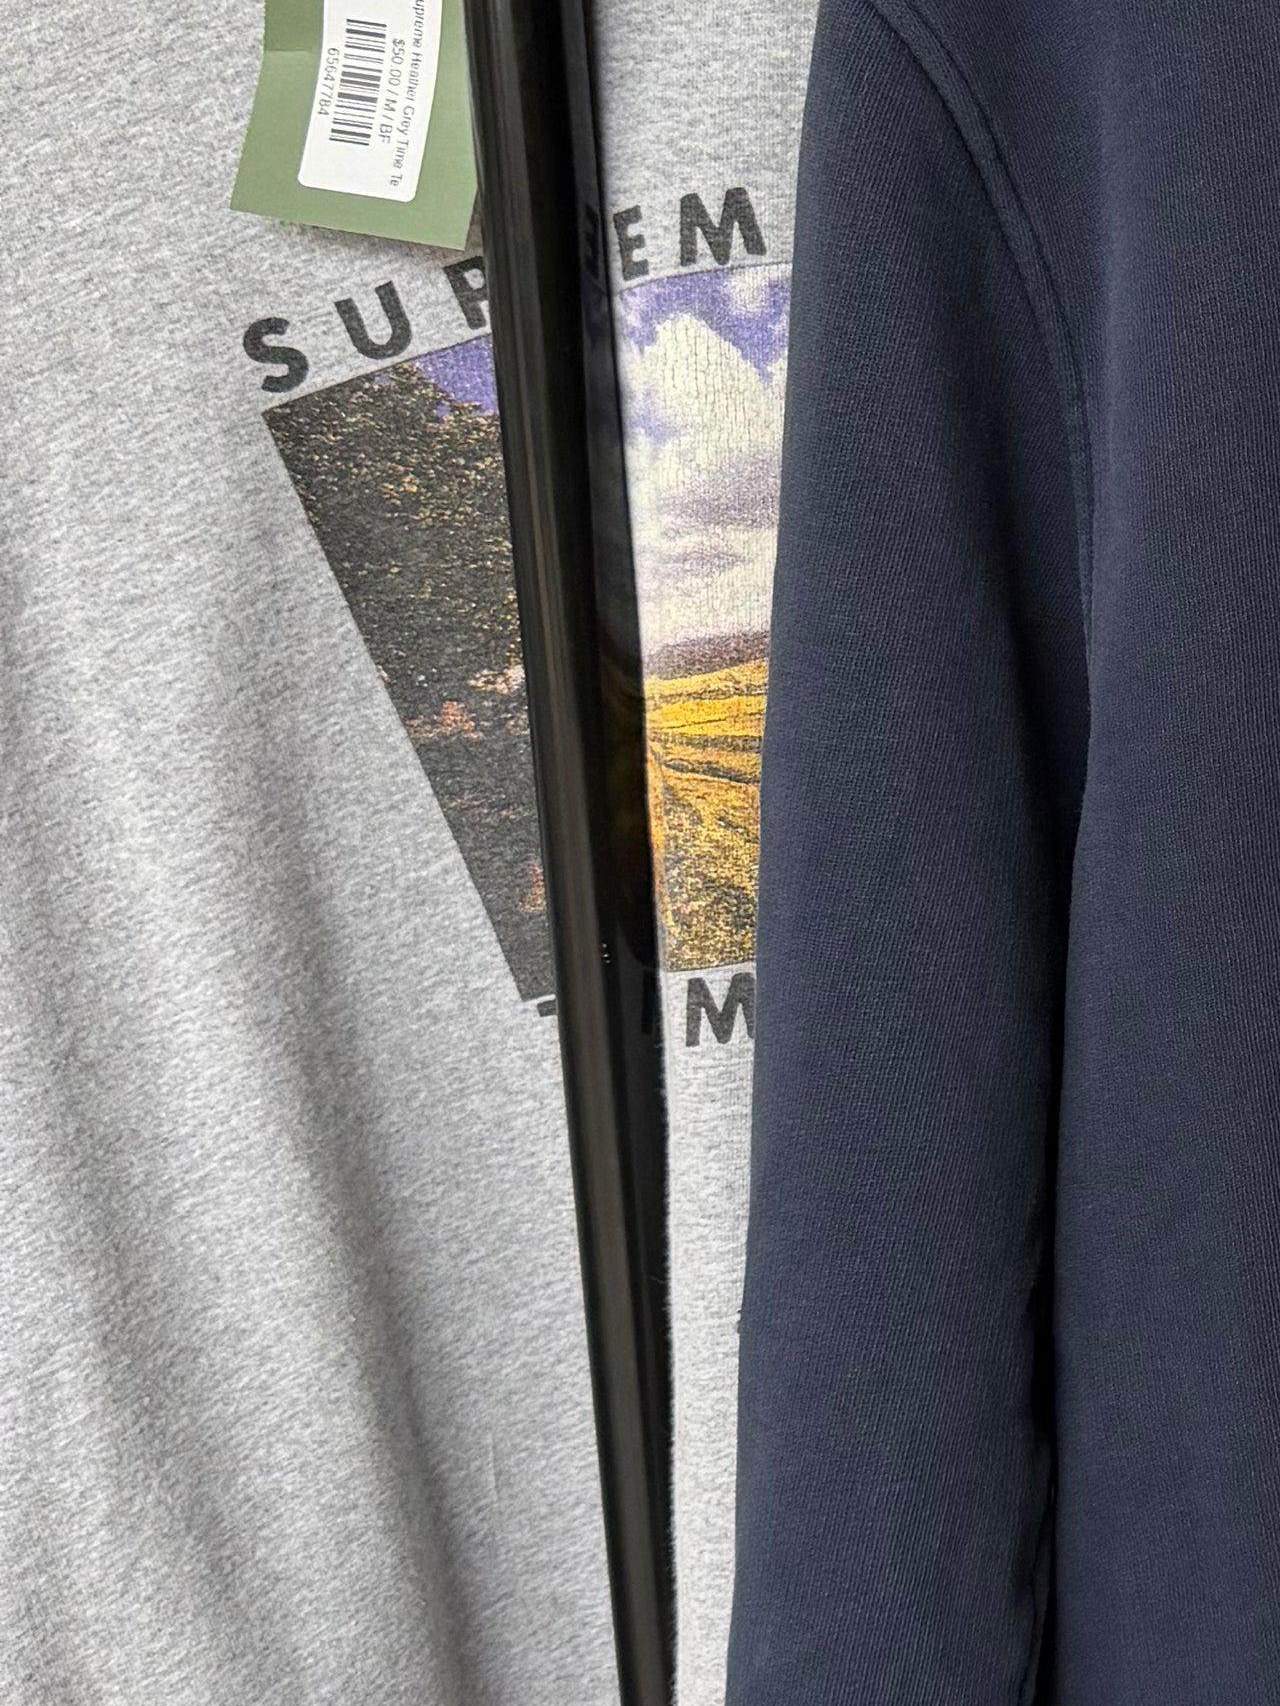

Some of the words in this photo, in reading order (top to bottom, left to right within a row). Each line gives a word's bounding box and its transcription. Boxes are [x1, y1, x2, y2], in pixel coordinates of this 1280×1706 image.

[388, 38, 405, 87] $50.00
[317, 47, 341, 117] 65647784
[408, 52, 424, 106] Heather
[377, 123, 394, 145] BF
[398, 106, 415, 136] Grey
[393, 139, 409, 170] Time
[389, 173, 404, 187] Te
